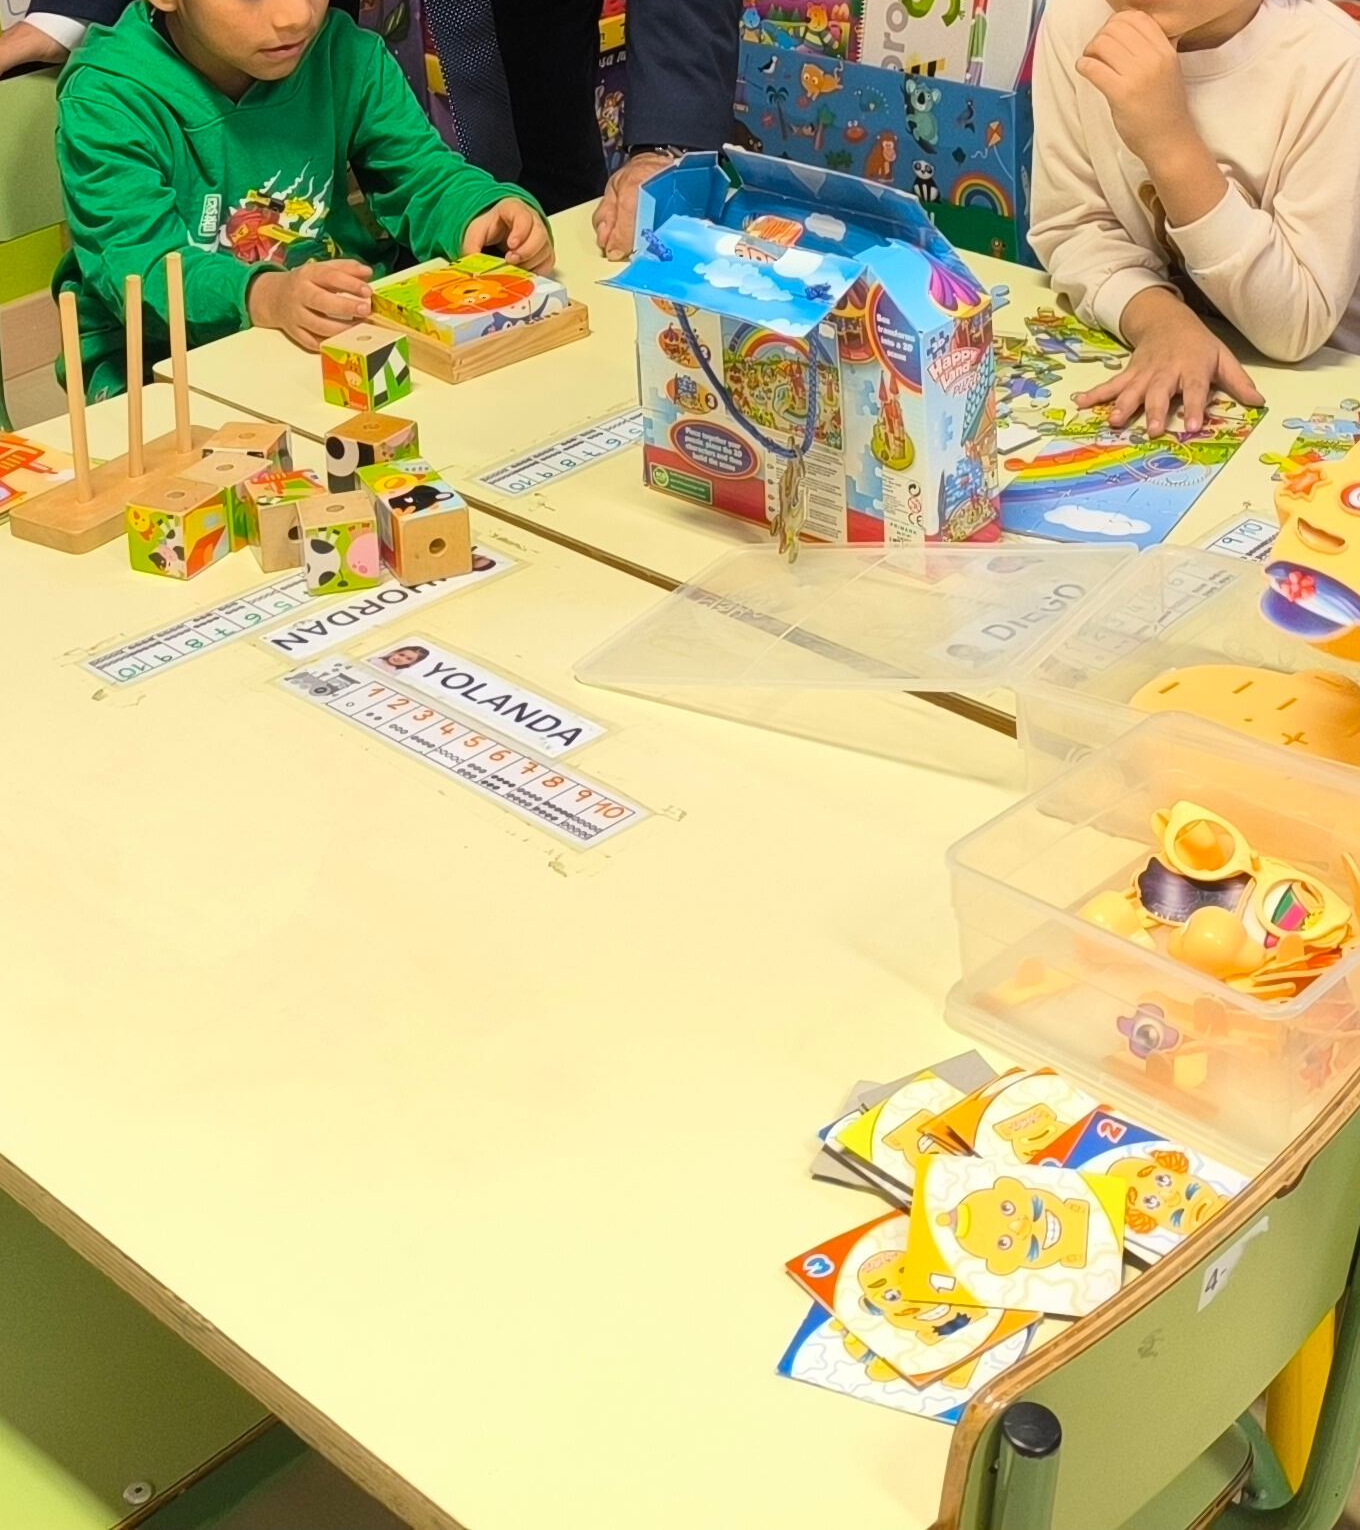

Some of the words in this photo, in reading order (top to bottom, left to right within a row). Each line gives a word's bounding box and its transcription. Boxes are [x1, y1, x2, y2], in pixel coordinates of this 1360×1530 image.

[926, 348, 980, 384] Happy
[939, 361, 973, 394] Land
[981, 583, 1087, 642] DIEGO
[423, 661, 584, 747] YOLANDA
[368, 686, 385, 699] 1
[387, 697, 411, 711] 2
[412, 709, 434, 723] 3
[439, 721, 456, 737] 4
[463, 733, 487, 749] 5
[489, 749, 512, 763] 6
[520, 760, 539, 776] 7
[541, 774, 565, 789] 8
[577, 788, 593, 804] 9
[593, 799, 626, 819] 10
